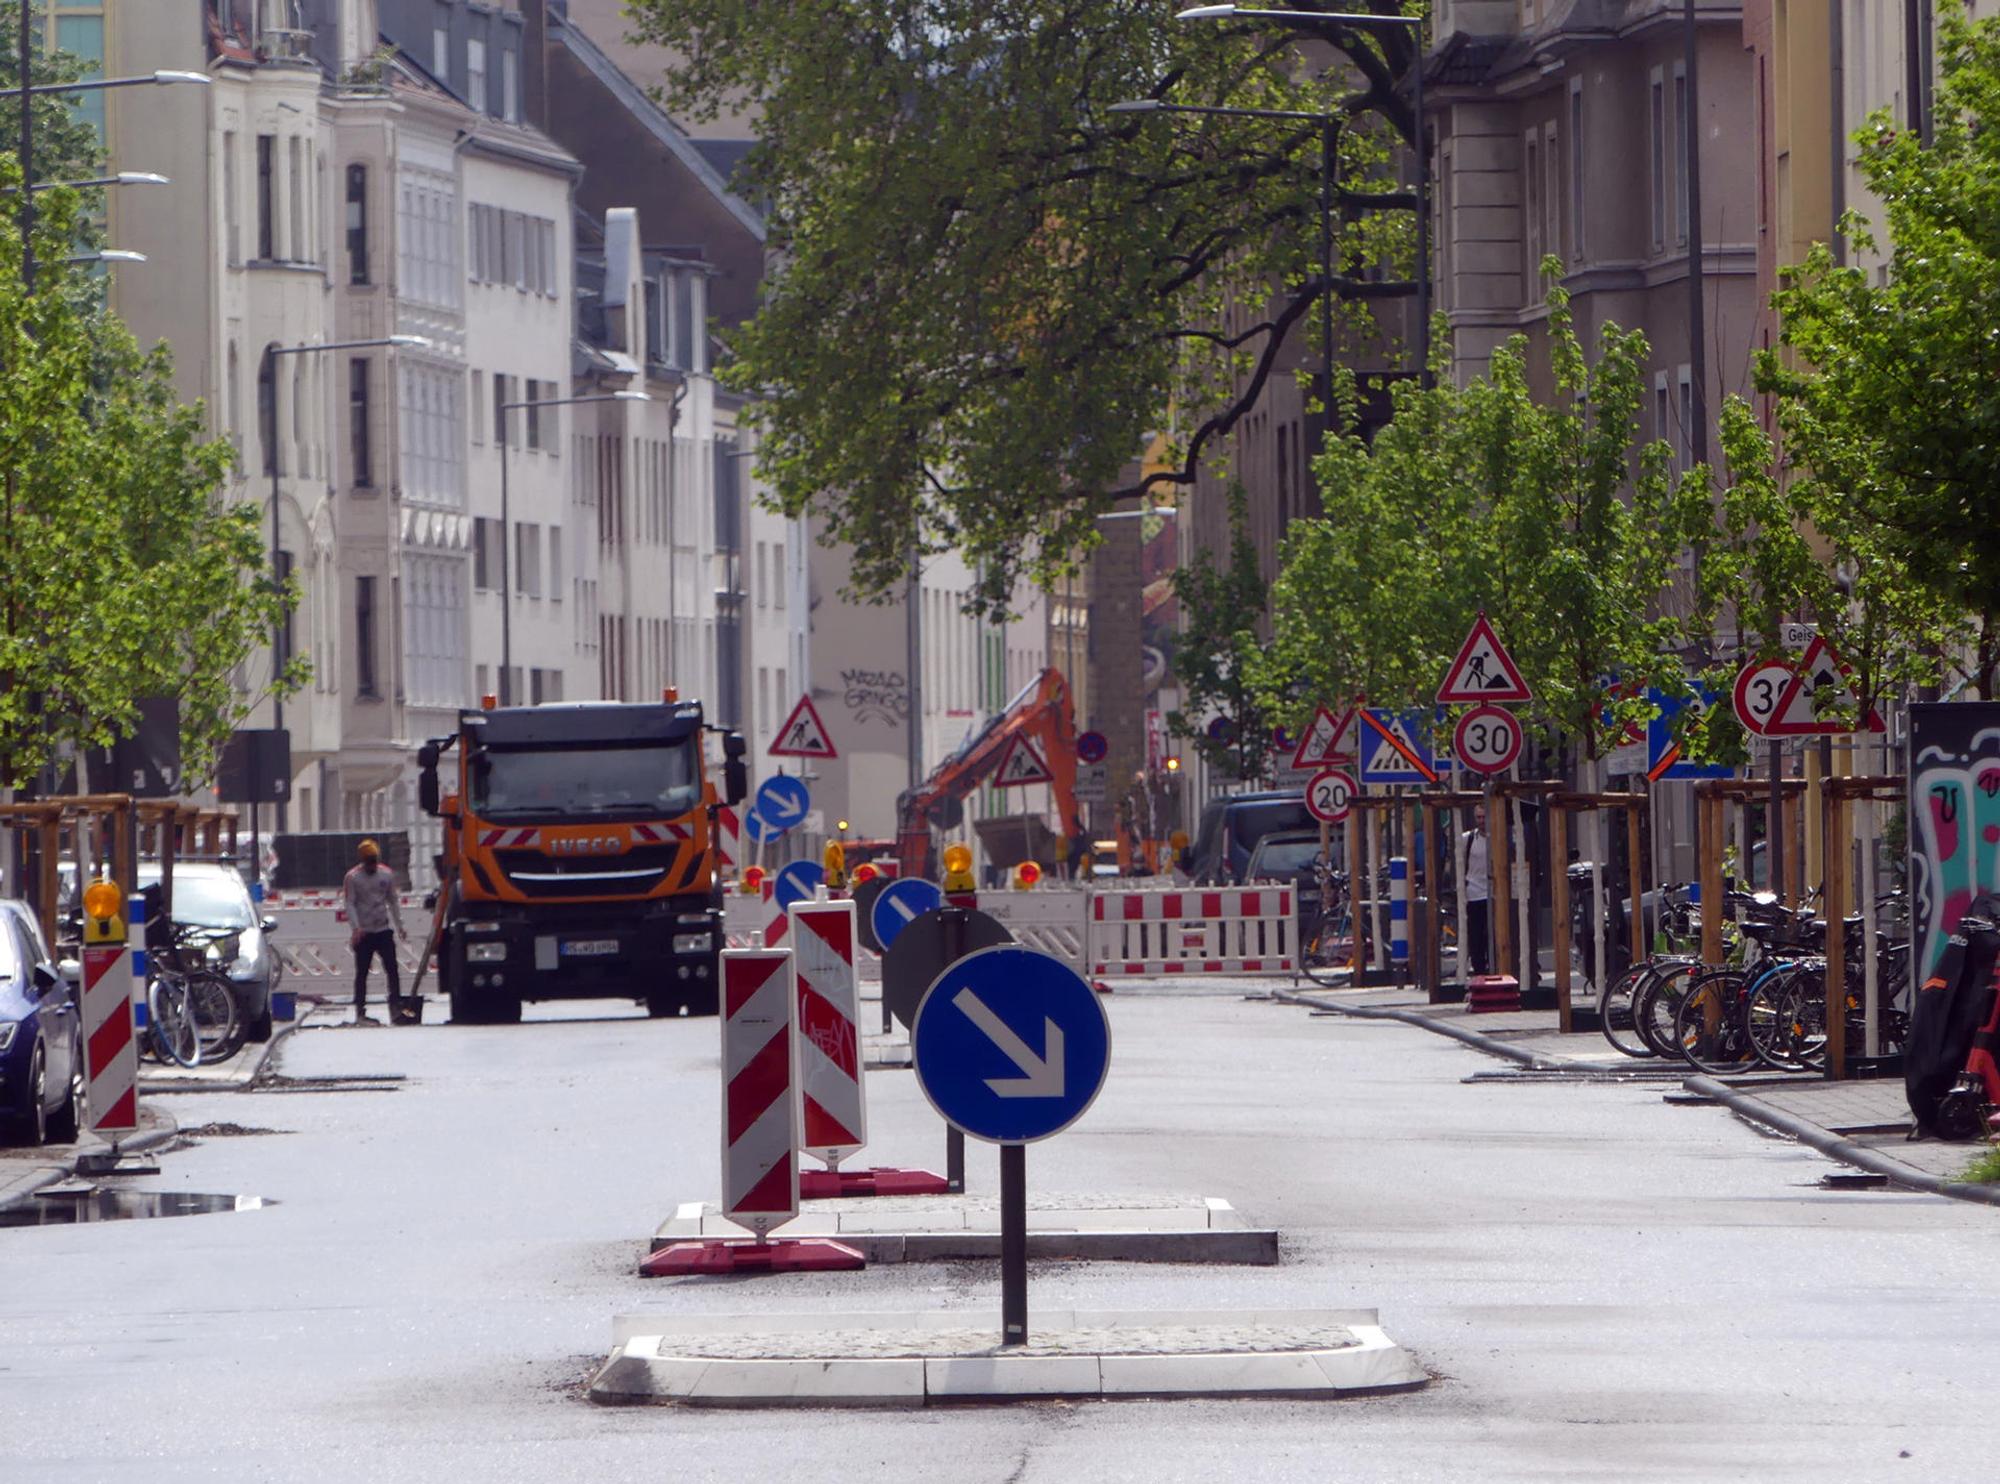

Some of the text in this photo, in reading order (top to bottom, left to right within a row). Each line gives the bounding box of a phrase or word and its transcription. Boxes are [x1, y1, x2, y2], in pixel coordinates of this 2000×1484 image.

[1788, 628, 1813, 642] Geis
[1469, 723, 1509, 756] 30
[1317, 784, 1347, 809] 20
[550, 835, 622, 854] IVECO
